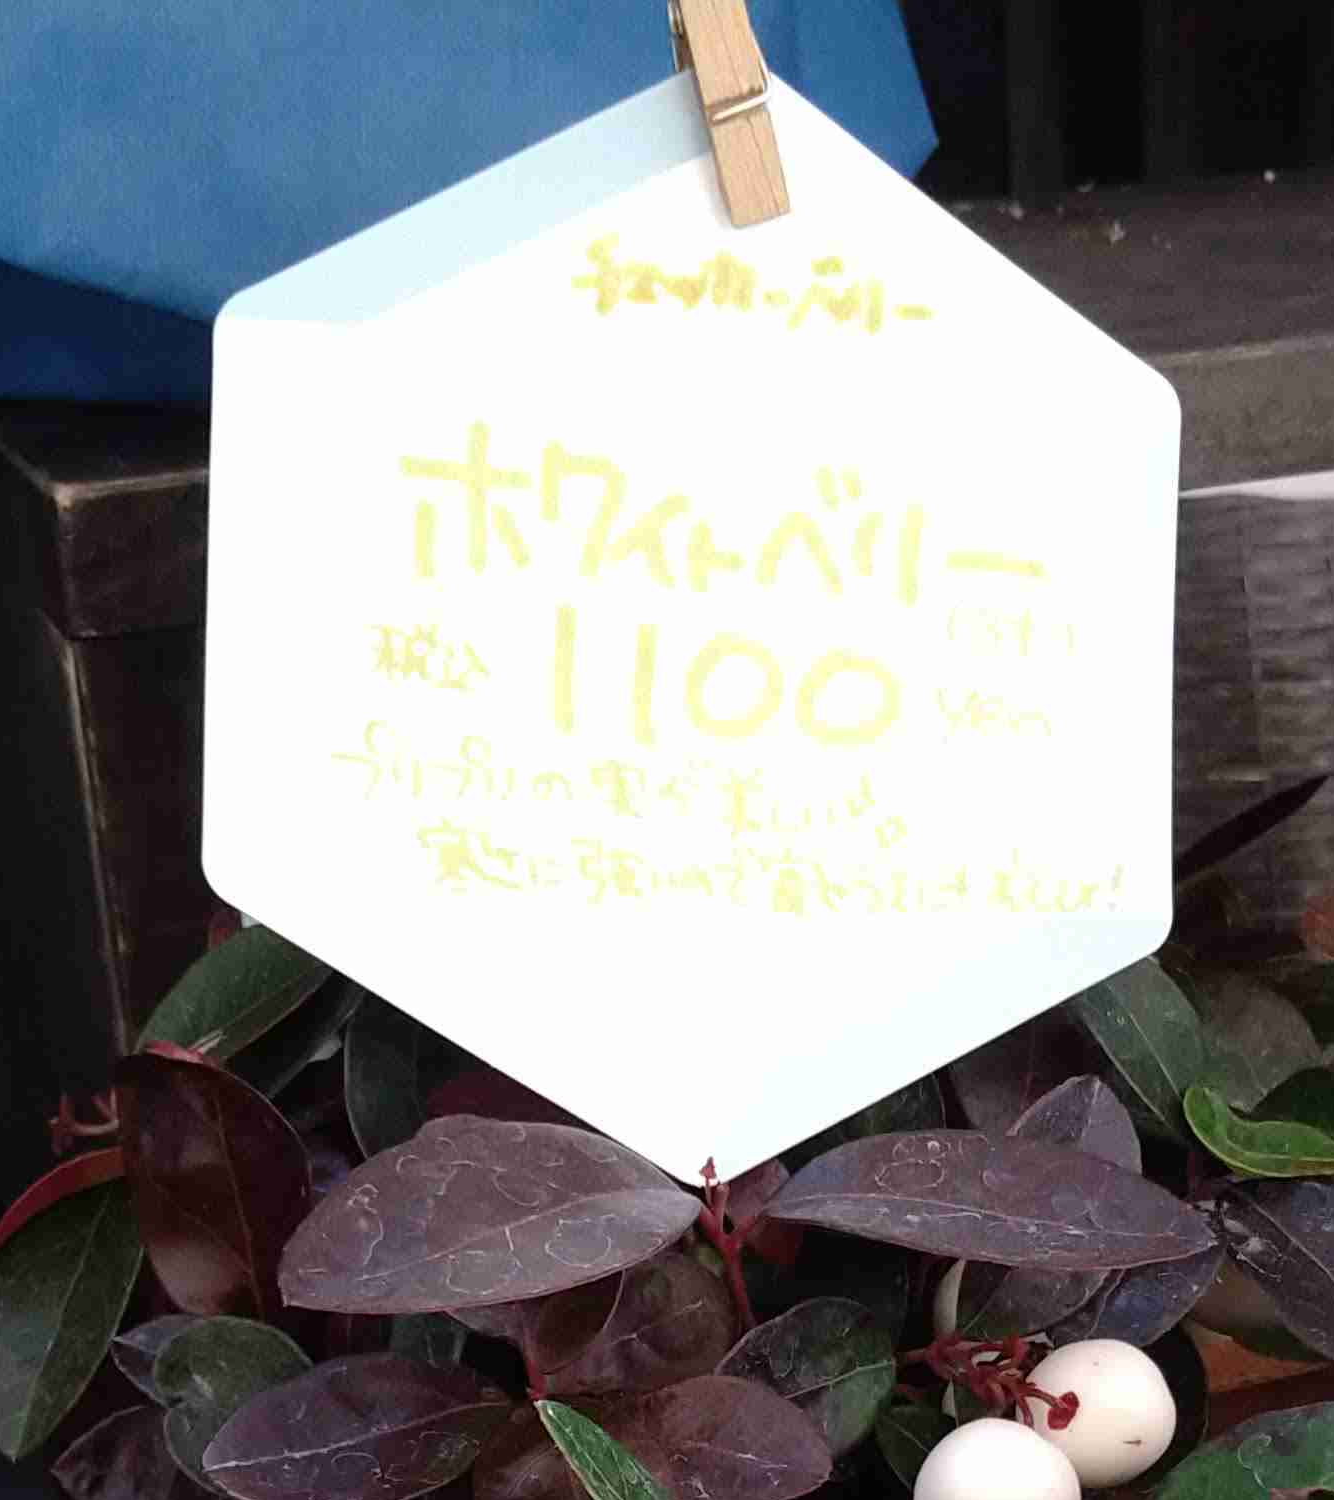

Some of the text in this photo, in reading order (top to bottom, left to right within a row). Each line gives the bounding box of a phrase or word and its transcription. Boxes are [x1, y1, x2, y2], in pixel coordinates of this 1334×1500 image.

[398, 419, 1051, 607] ホワイトベリー
[548, 601, 903, 748] 1100
